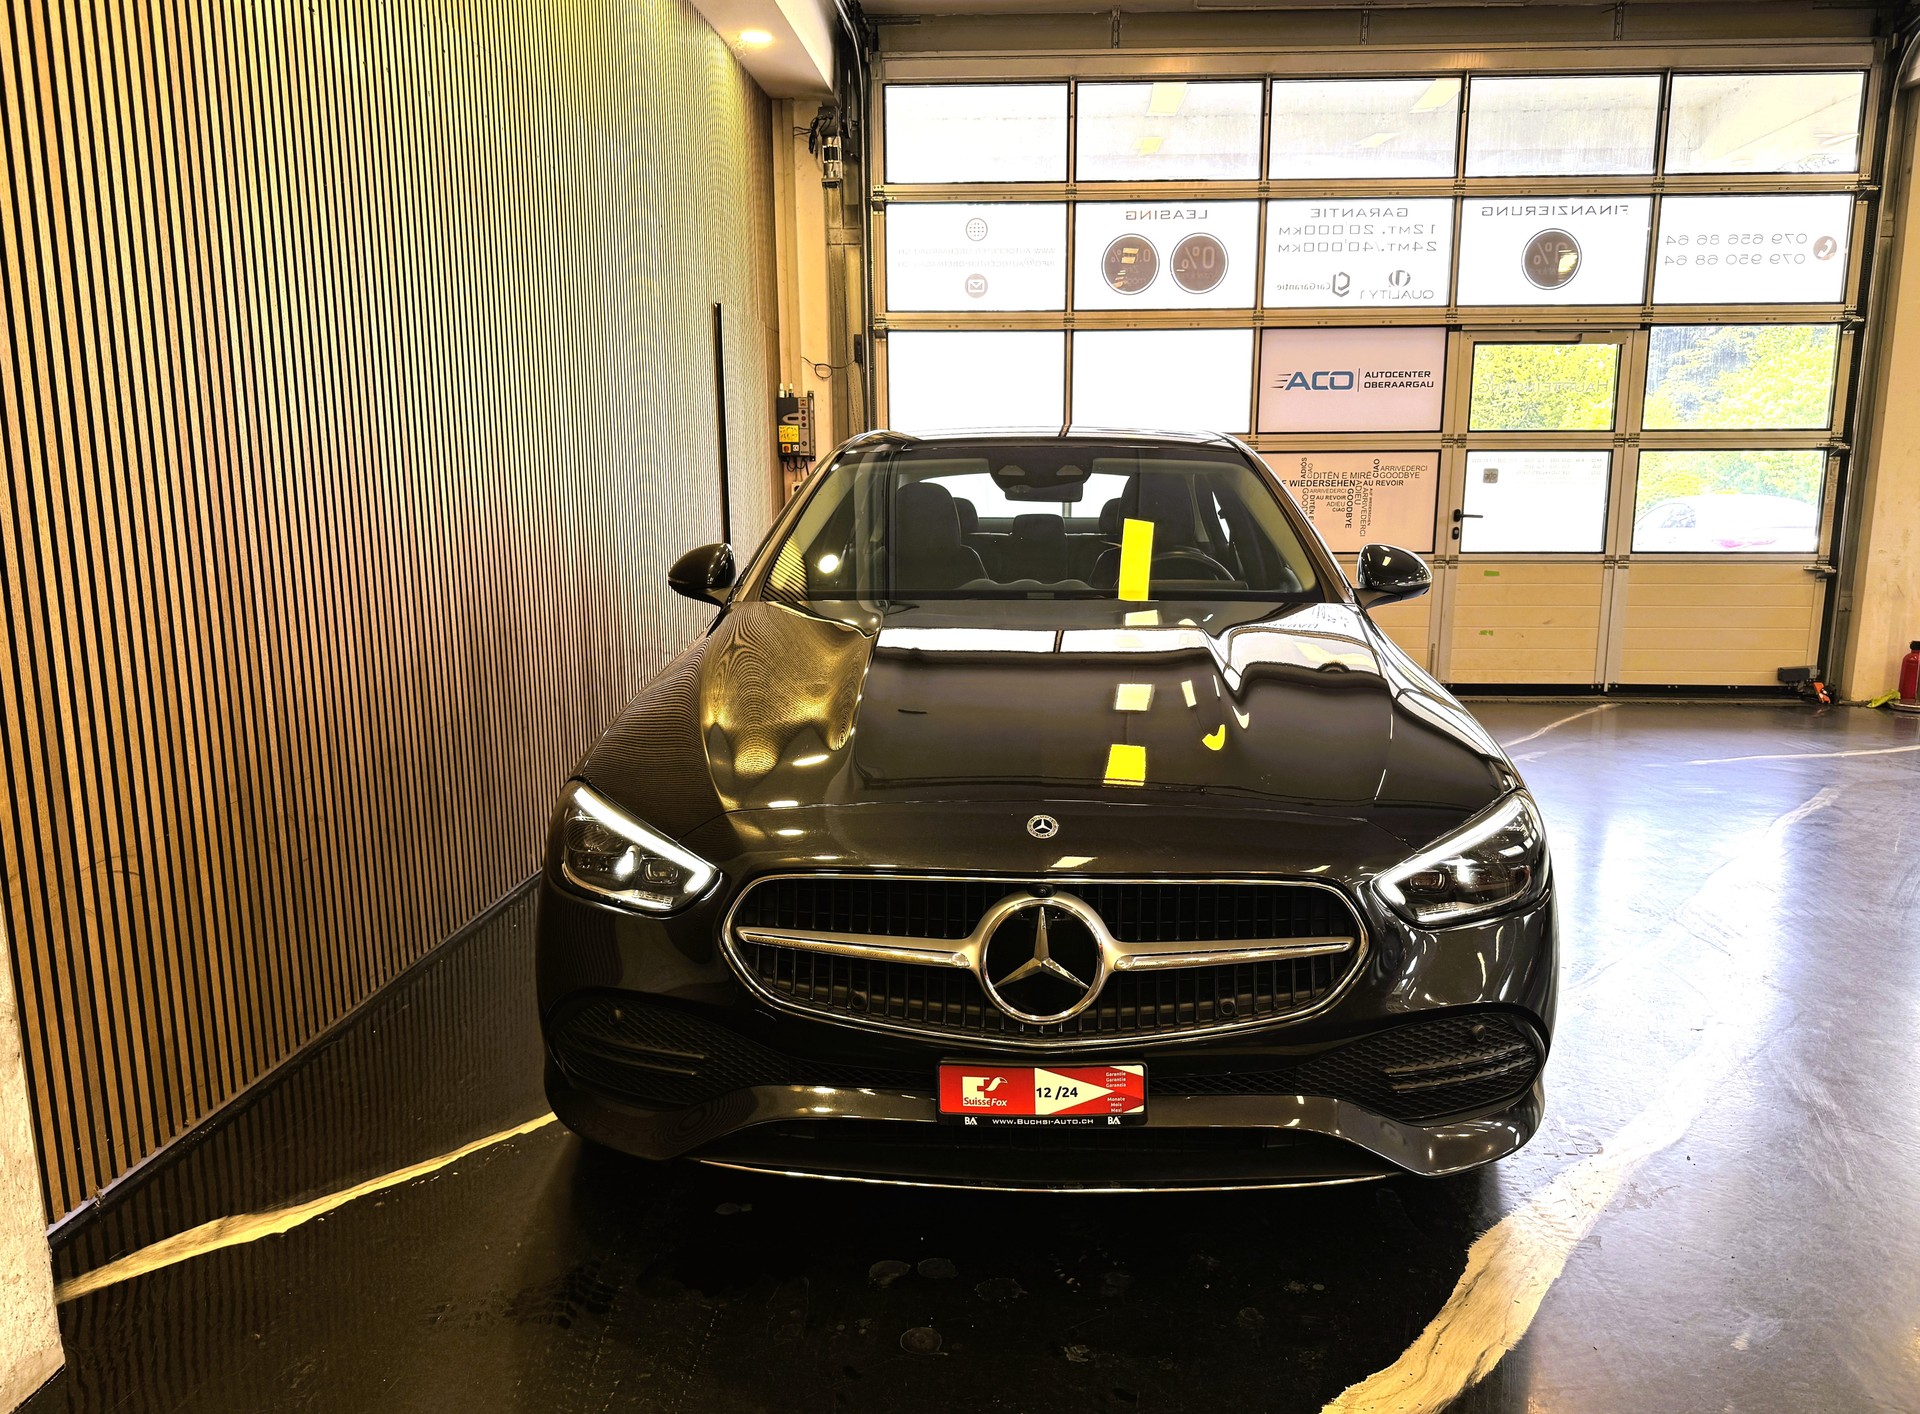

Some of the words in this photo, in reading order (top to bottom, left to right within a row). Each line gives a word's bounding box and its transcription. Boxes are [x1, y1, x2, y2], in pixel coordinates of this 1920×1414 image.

[1285, 371, 1354, 391] ACO
[1363, 380, 1434, 389] OBERAARGAU
[1364, 370, 1431, 379] AUTOCENTER
[1300, 457, 1308, 479] ADIOS
[1342, 472, 1347, 480] E
[1380, 471, 1420, 479] GOODBYE
[1301, 487, 1309, 515] GOOD
[1354, 480, 1363, 506] ADIEU
[1345, 488, 1354, 529] GOODBYE
[1359, 487, 1369, 537] ARRIVEDERCI
[1035, 1087, 1052, 1098] 12
[1055, 1086, 1079, 1100] /24
